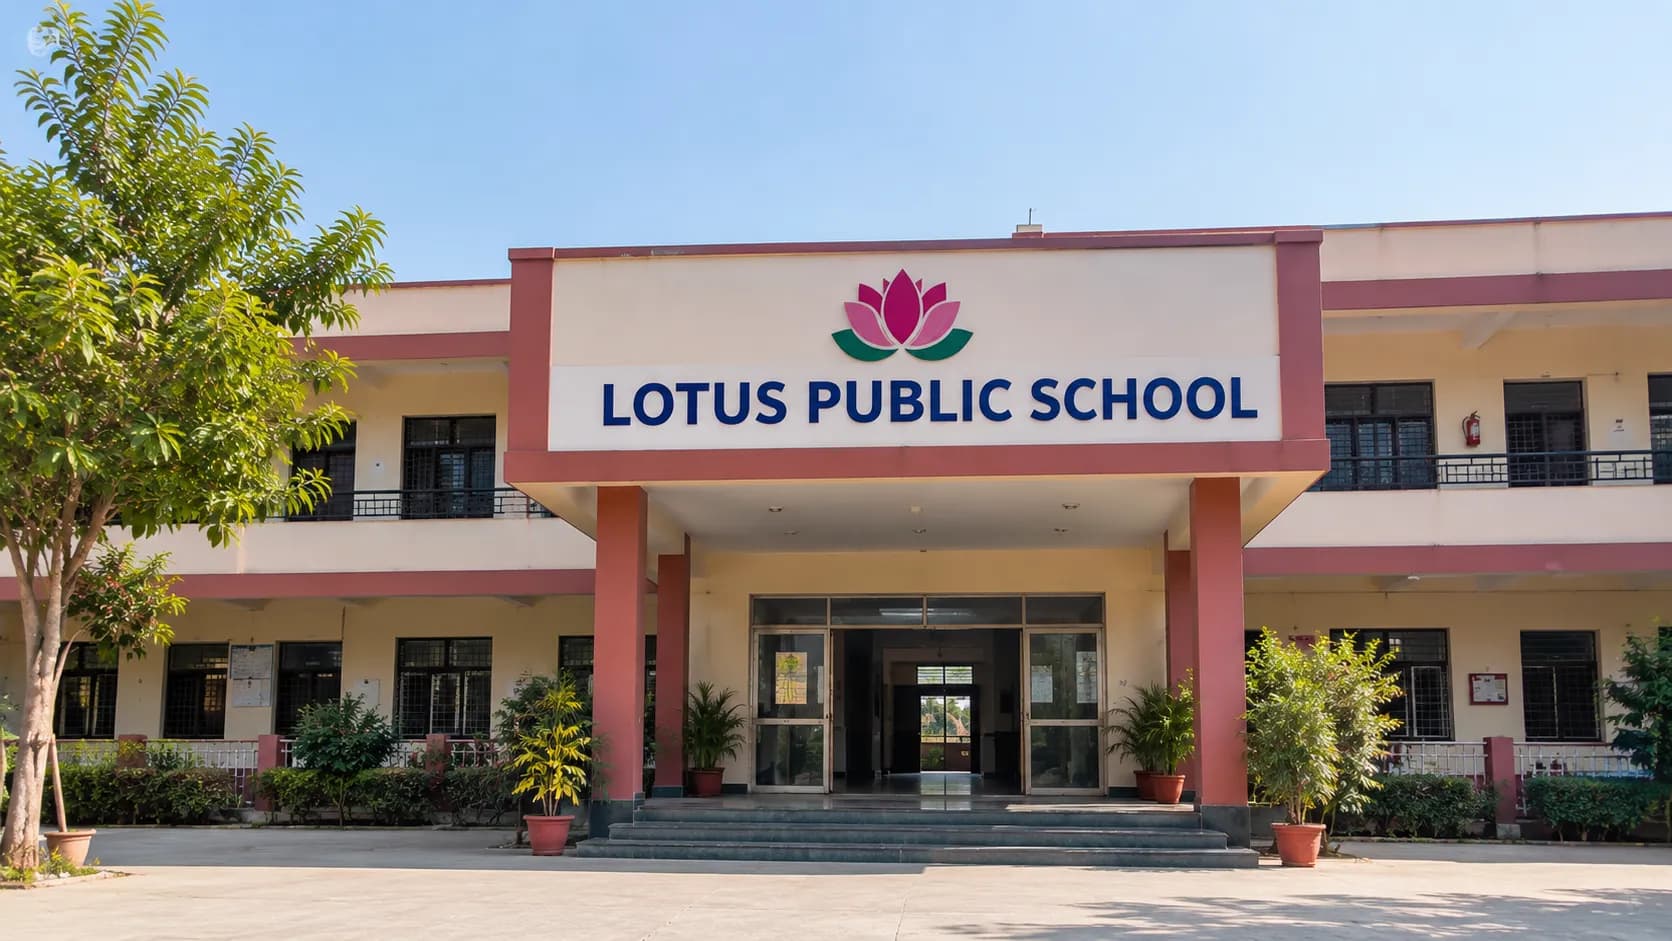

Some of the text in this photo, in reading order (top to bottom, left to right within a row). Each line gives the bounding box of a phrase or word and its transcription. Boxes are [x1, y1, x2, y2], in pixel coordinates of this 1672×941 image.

[603, 377, 1258, 427] LOTUS PUBLIC SCHOOL
